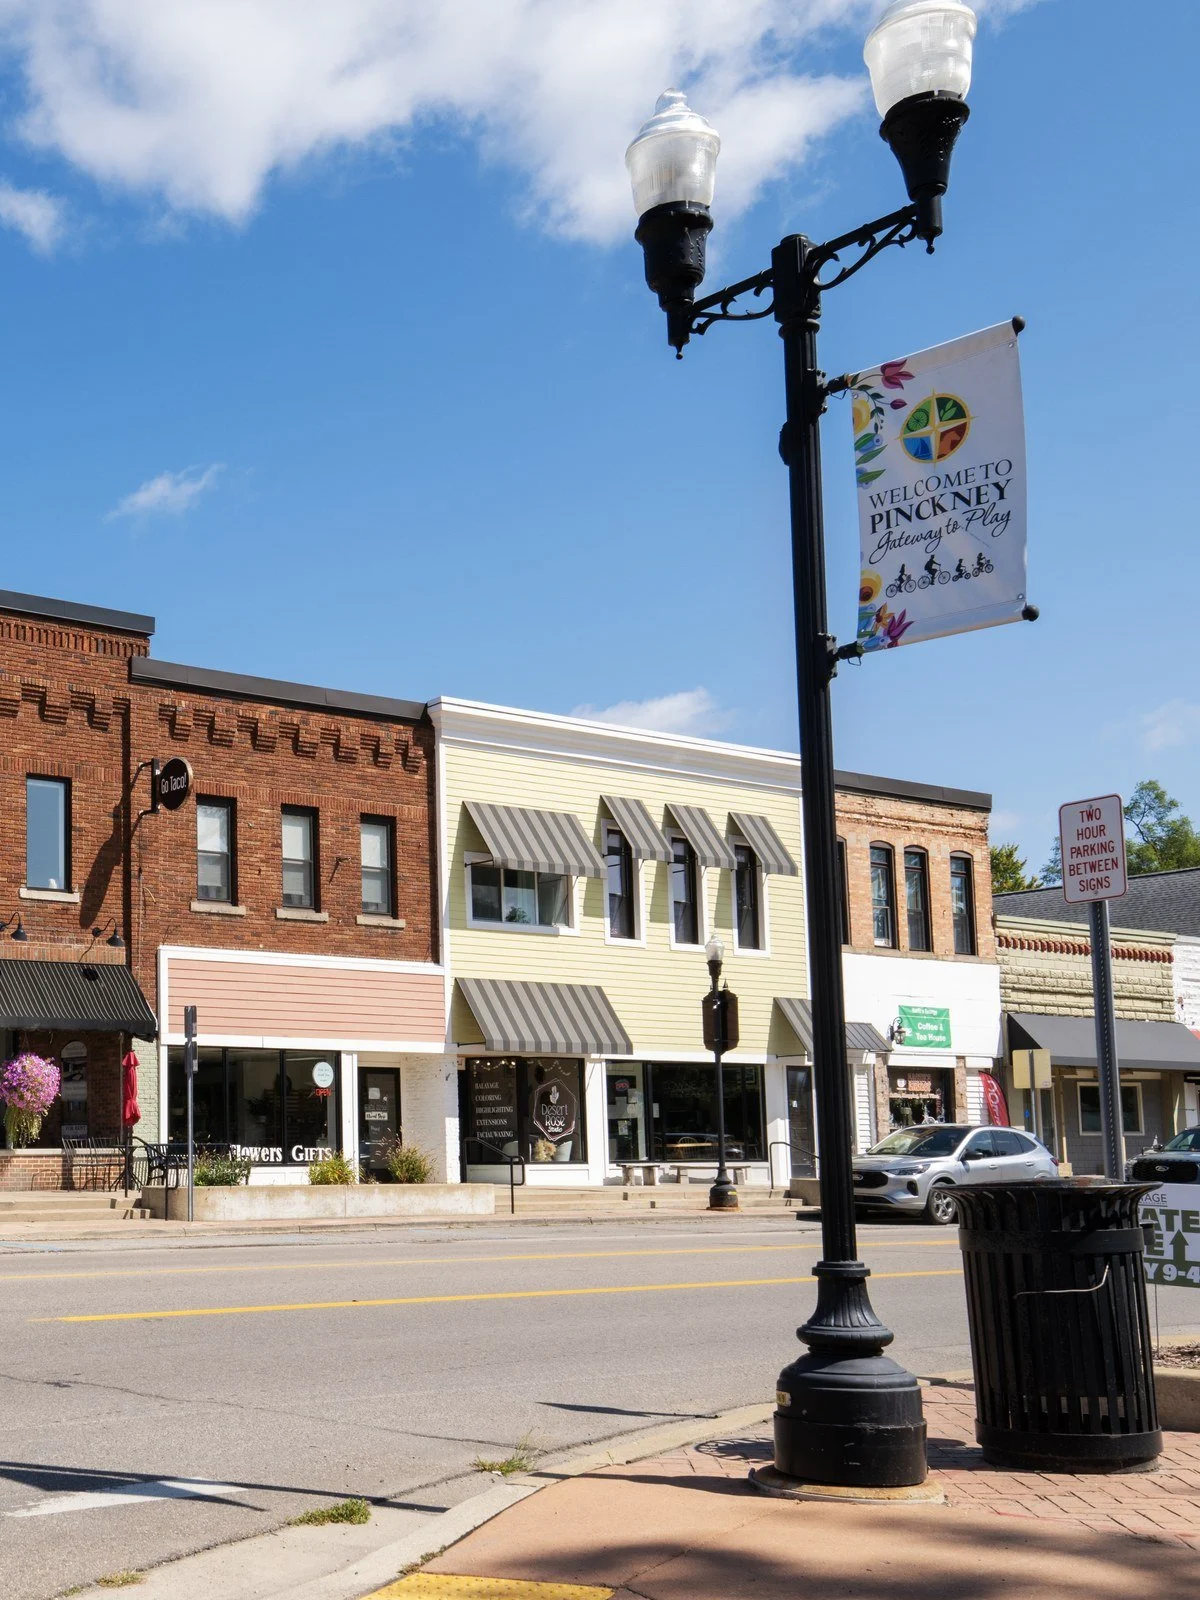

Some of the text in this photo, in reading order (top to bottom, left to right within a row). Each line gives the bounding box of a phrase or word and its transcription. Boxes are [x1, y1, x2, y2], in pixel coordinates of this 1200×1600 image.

[869, 459, 1013, 509] WELCOME TO
[870, 478, 1013, 535] PINCKNEY
[869, 502, 1011, 565] Gateway to Play
[161, 772, 187, 794] Go Taco!
[1079, 808, 1102, 823] TWO
[1076, 824, 1106, 841] HOUR
[1070, 840, 1115, 859] PARKING
[1068, 857, 1119, 877] BETWEEN
[1078, 876, 1111, 892] SIGNS
[917, 1022, 939, 1031] Coffee
[928, 1033, 947, 1042] House
[315, 1088, 332, 1097] OPEN
[474, 1082, 500, 1090] BALAYAGE
[475, 1094, 502, 1102] COLORING
[475, 1106, 514, 1114] HIGHLIGHTING
[291, 1145, 333, 1162] GIFTS
[1139, 1193, 1168, 1203] AGE
[1138, 1208, 1200, 1233] ATE
